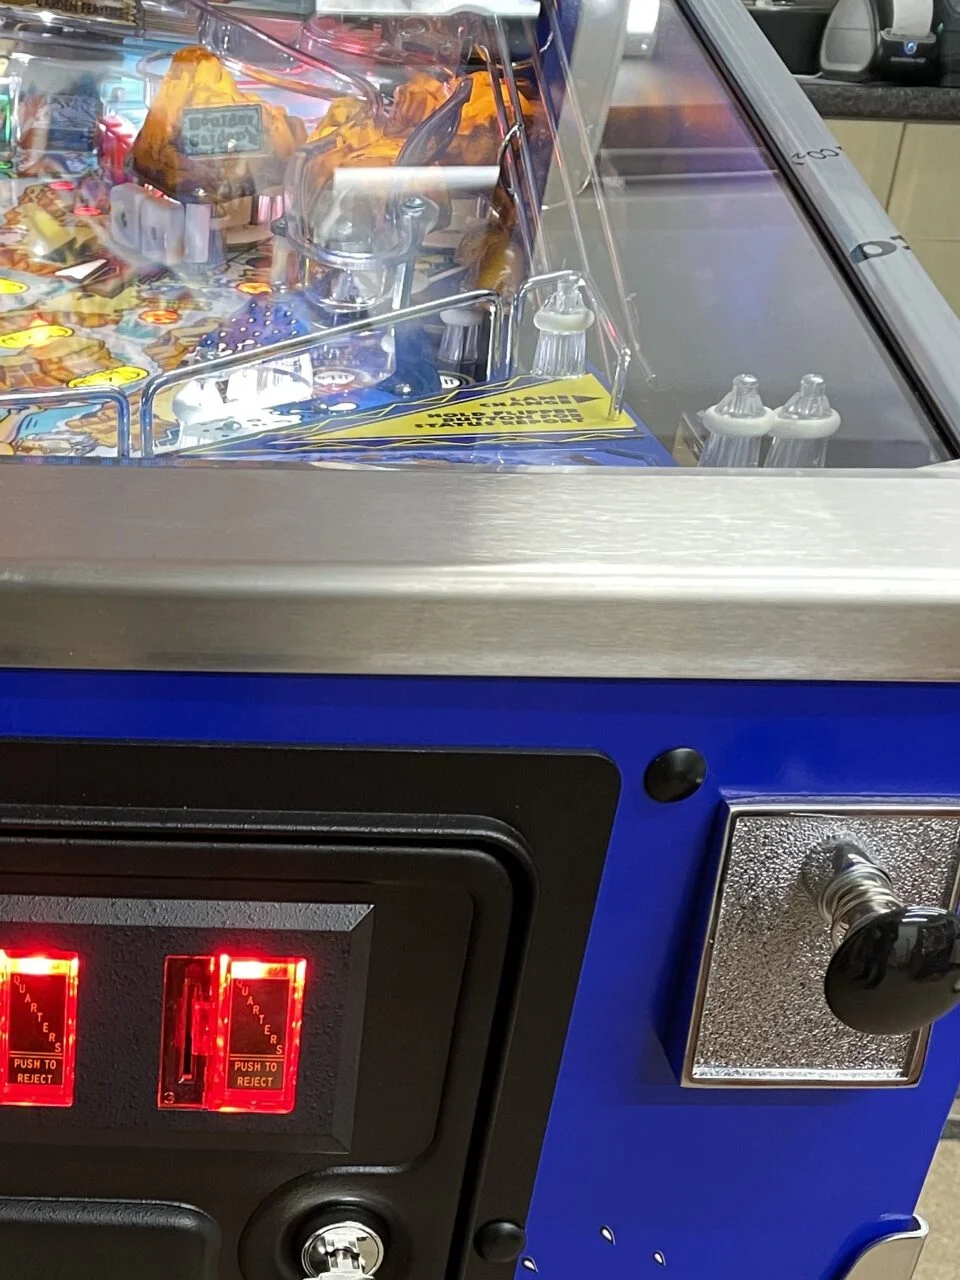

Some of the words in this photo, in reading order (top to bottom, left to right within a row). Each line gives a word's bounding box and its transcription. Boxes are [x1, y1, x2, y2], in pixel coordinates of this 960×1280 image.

[13, 975, 62, 1053] QUARTERS
[236, 980, 283, 1055] QUARTERS
[13, 1058, 41, 1069] PUSH
[44, 1059, 57, 1070] TO
[234, 1061, 262, 1072] PUSH
[265, 1062, 278, 1072] TO
[17, 1073, 53, 1085] REJECT
[237, 1076, 274, 1088] REJECT
